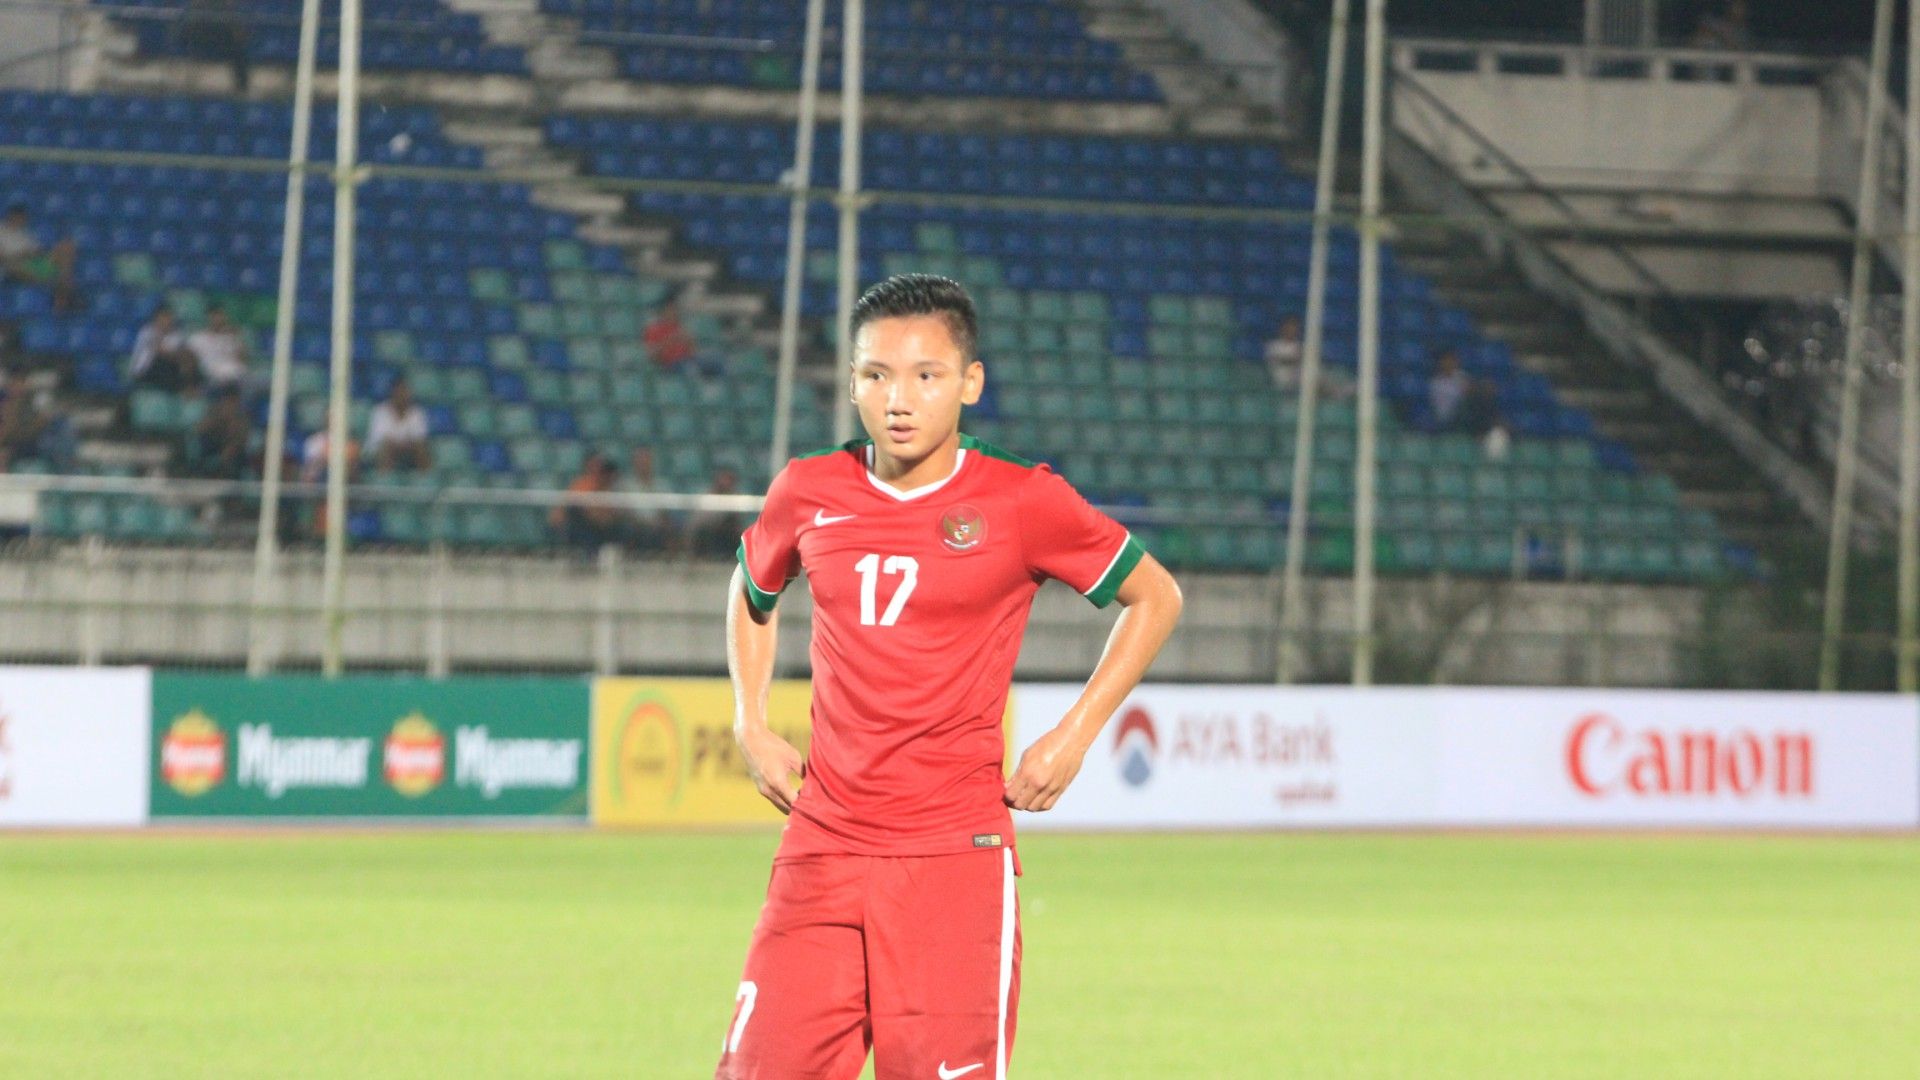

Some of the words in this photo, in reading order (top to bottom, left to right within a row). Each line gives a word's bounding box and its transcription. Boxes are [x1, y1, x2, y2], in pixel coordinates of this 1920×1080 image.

[854, 553, 919, 626] 17
[1170, 713, 1242, 763] AYA
[1254, 710, 1335, 765] Bank
[1564, 712, 1815, 797] Canon
